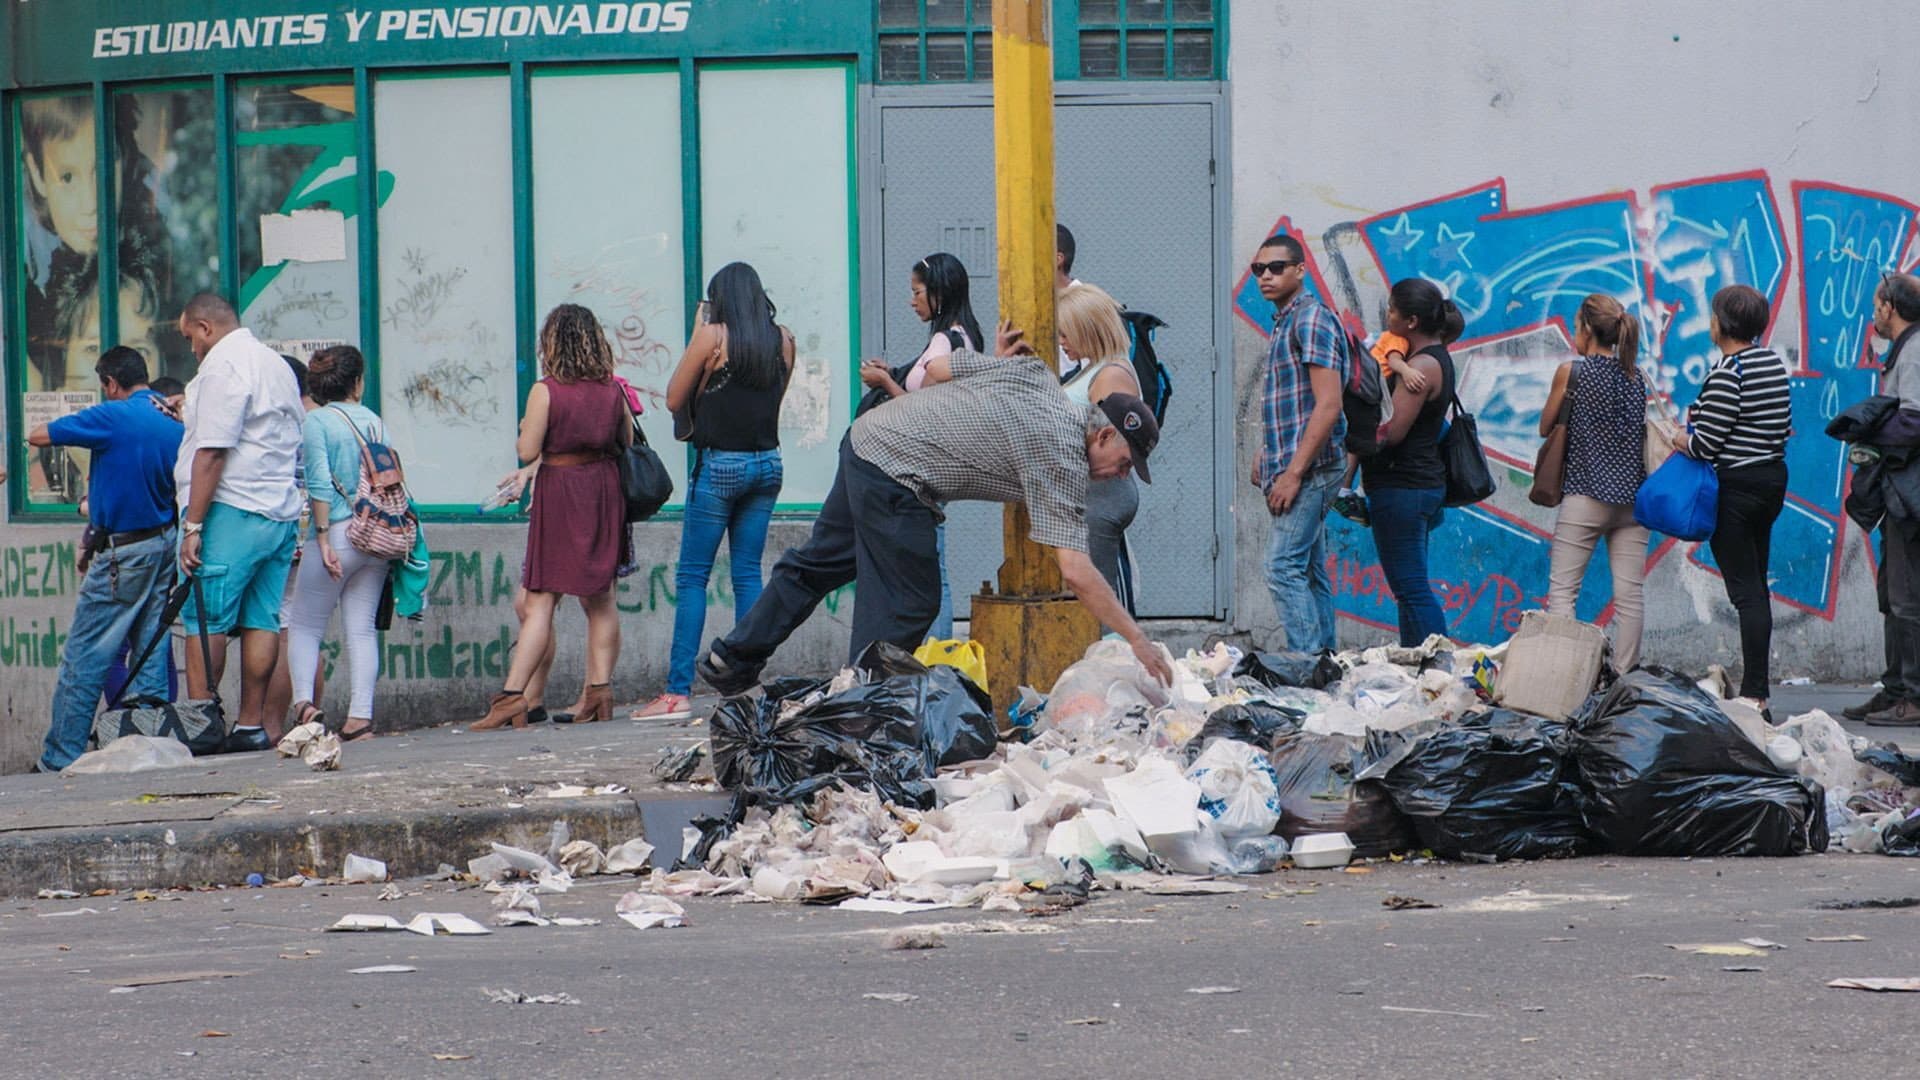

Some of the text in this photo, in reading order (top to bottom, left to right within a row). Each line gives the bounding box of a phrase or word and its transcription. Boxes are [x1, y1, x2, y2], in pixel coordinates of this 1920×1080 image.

[92, 2, 691, 58] ESTUDIANTES Y PENSIONADOS
